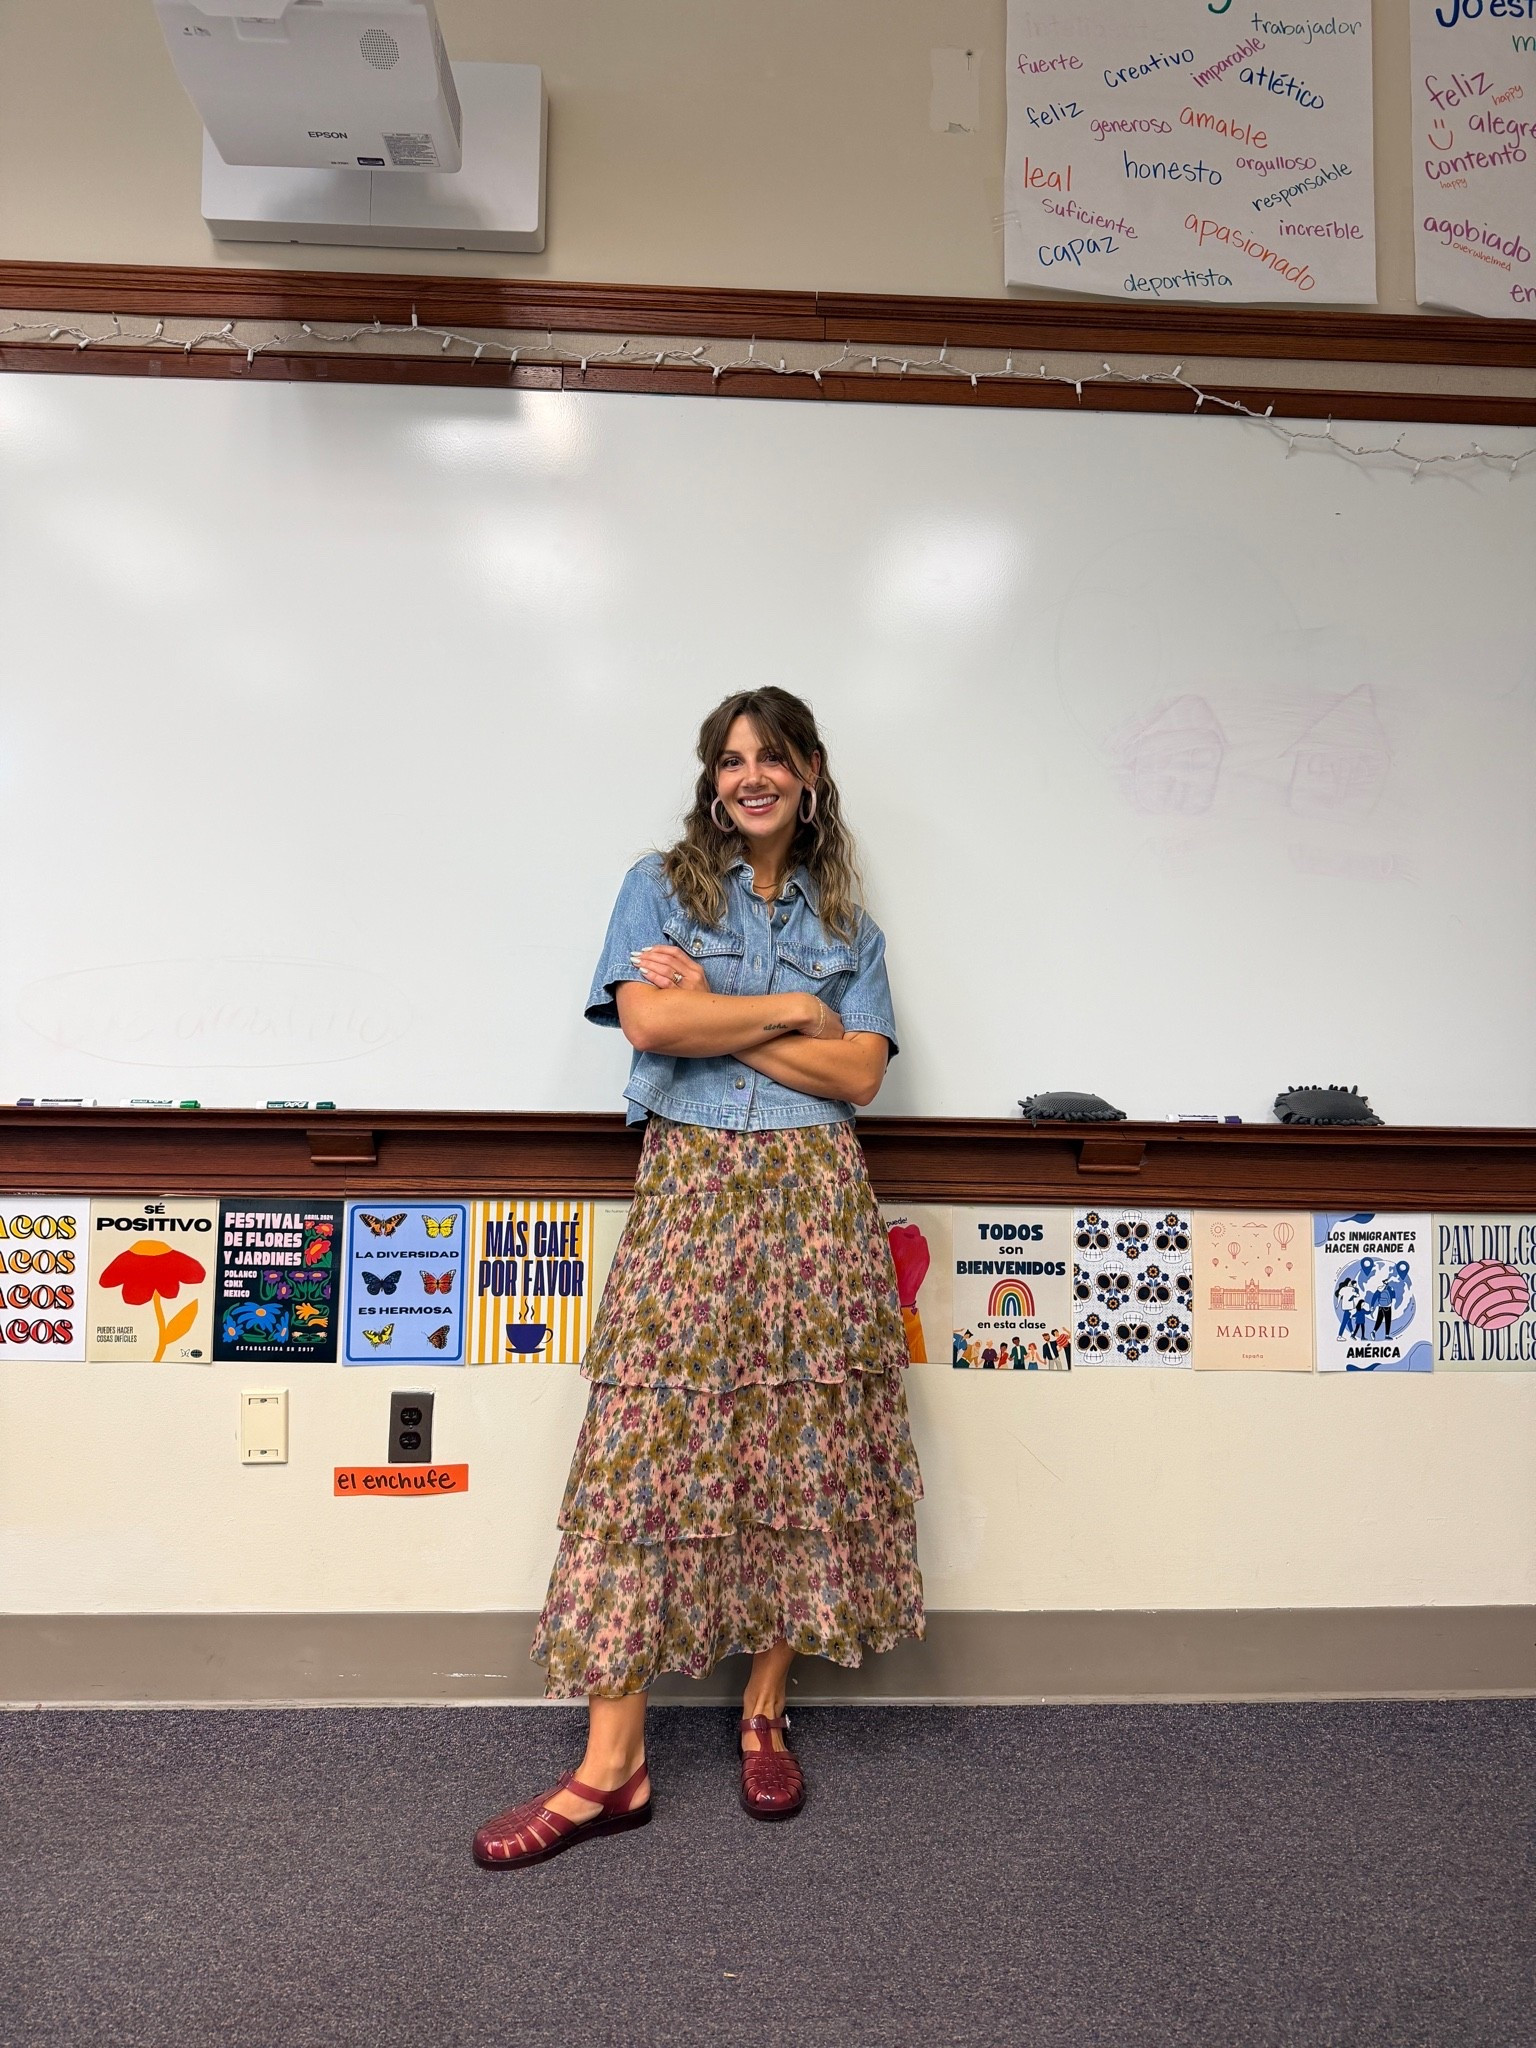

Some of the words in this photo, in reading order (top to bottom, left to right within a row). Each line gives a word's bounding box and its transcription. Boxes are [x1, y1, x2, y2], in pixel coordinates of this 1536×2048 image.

[1251, 12, 1362, 45] trabajador
[1017, 53, 1084, 75] fuerte
[1190, 36, 1266, 88] imparable
[1239, 66, 1325, 109] atlético
[1425, 72, 1494, 111] feliz
[1491, 85, 1524, 106] happy
[1026, 102, 1084, 129] feliz
[307, 131, 348, 139] EPSON
[1090, 118, 1173, 142] generoso
[1179, 106, 1268, 149] amable
[1123, 150, 1222, 186] honesto
[1236, 156, 1317, 178] orgulloso
[1425, 144, 1527, 180] contento
[1024, 156, 1071, 192] leal
[1439, 177, 1468, 190] happy
[1252, 162, 1353, 212] responsable
[1041, 198, 1138, 240] suficiente
[1279, 219, 1364, 240] increíble
[1423, 216, 1531, 263] agobiado
[1038, 236, 1120, 266] capaz
[1184, 213, 1316, 291] apasionado
[1452, 241, 1512, 272] overwhelmed
[1123, 268, 1233, 297] deportista
[144, 1202, 165, 1214] SÉ
[97, 1217, 212, 1232] POSITIVO
[225, 1212, 304, 1230] FESTIVAL
[224, 1231, 243, 1247] DE
[245, 1232, 303, 1248] FLORES
[485, 1212, 528, 1258] MÁS
[534, 1212, 580, 1258] CAFÉ
[977, 1223, 1044, 1242] TODOS
[1327, 1231, 1346, 1242] LOS
[1348, 1230, 1417, 1241] INMIGRANTES
[355, 1251, 374, 1259] LA
[376, 1251, 460, 1259] DIVERSIDAD
[998, 1244, 1024, 1255] son
[1325, 1243, 1361, 1254] HACEN
[1362, 1243, 1405, 1253] GRANDE
[1407, 1243, 1416, 1253] A
[1438, 1225, 1475, 1265] PAN
[223, 1251, 233, 1265] Y
[234, 1251, 302, 1266] JARDINES
[956, 1260, 1066, 1276] BIENVENIDOS
[224, 1270, 258, 1279] POLANCO
[224, 1280, 243, 1288] CDMX
[478, 1260, 517, 1297] POR
[523, 1260, 584, 1297] FAVOR
[358, 1306, 378, 1315] ES
[379, 1306, 453, 1314] HERMOSA
[0, 1319, 73, 1344] COS
[97, 1326, 116, 1334] PUEDES
[116, 1326, 134, 1334] HACER
[977, 1321, 991, 1330] en
[993, 1320, 1017, 1330] esta
[1018, 1318, 1047, 1330] clase
[1216, 1325, 1290, 1339] MADRID
[97, 1335, 114, 1343] COSAS
[1438, 1320, 1475, 1361] PAN
[1346, 1343, 1401, 1359] AMÉRICA
[337, 1472, 357, 1490] el
[362, 1469, 457, 1490] enchufe
